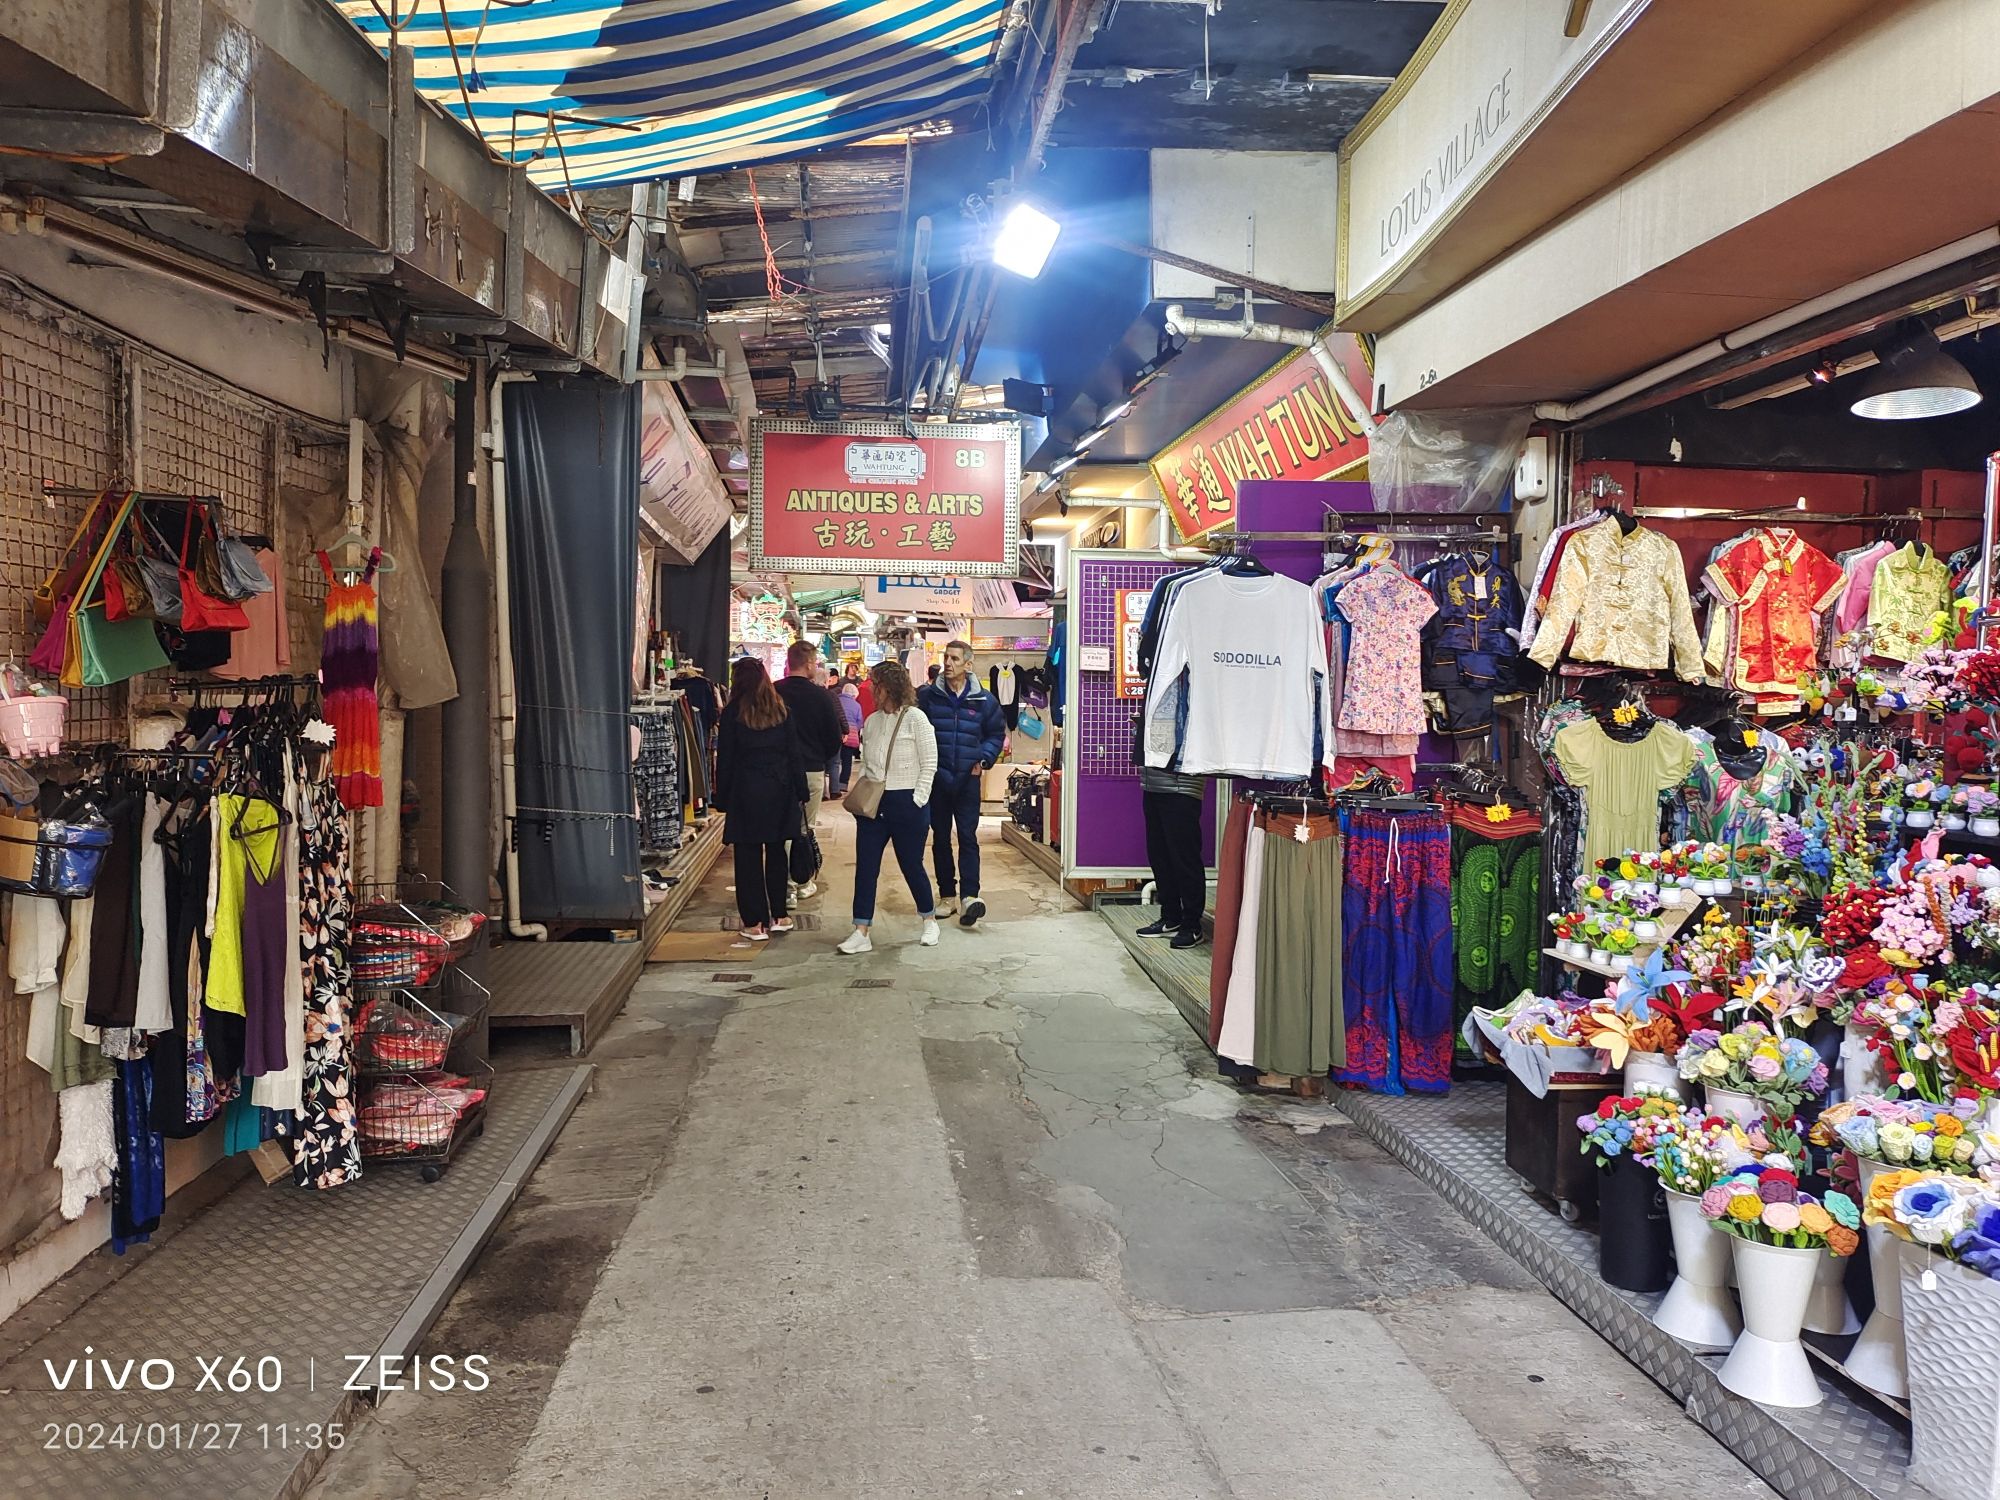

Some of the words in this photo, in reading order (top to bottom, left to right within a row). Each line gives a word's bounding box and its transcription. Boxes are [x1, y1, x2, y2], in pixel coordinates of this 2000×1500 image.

[1380, 168, 1432, 258] LOTUS
[1438, 67, 1512, 194] VILLAGE
[954, 449, 986, 468] 8B
[1212, 414, 1285, 486] WAH
[785, 489, 898, 514] ANTIQUES
[904, 492, 921, 514] &
[926, 493, 984, 516] ARTS
[1169, 442, 1232, 530] 華通
[1131, 686, 1146, 695] 28
